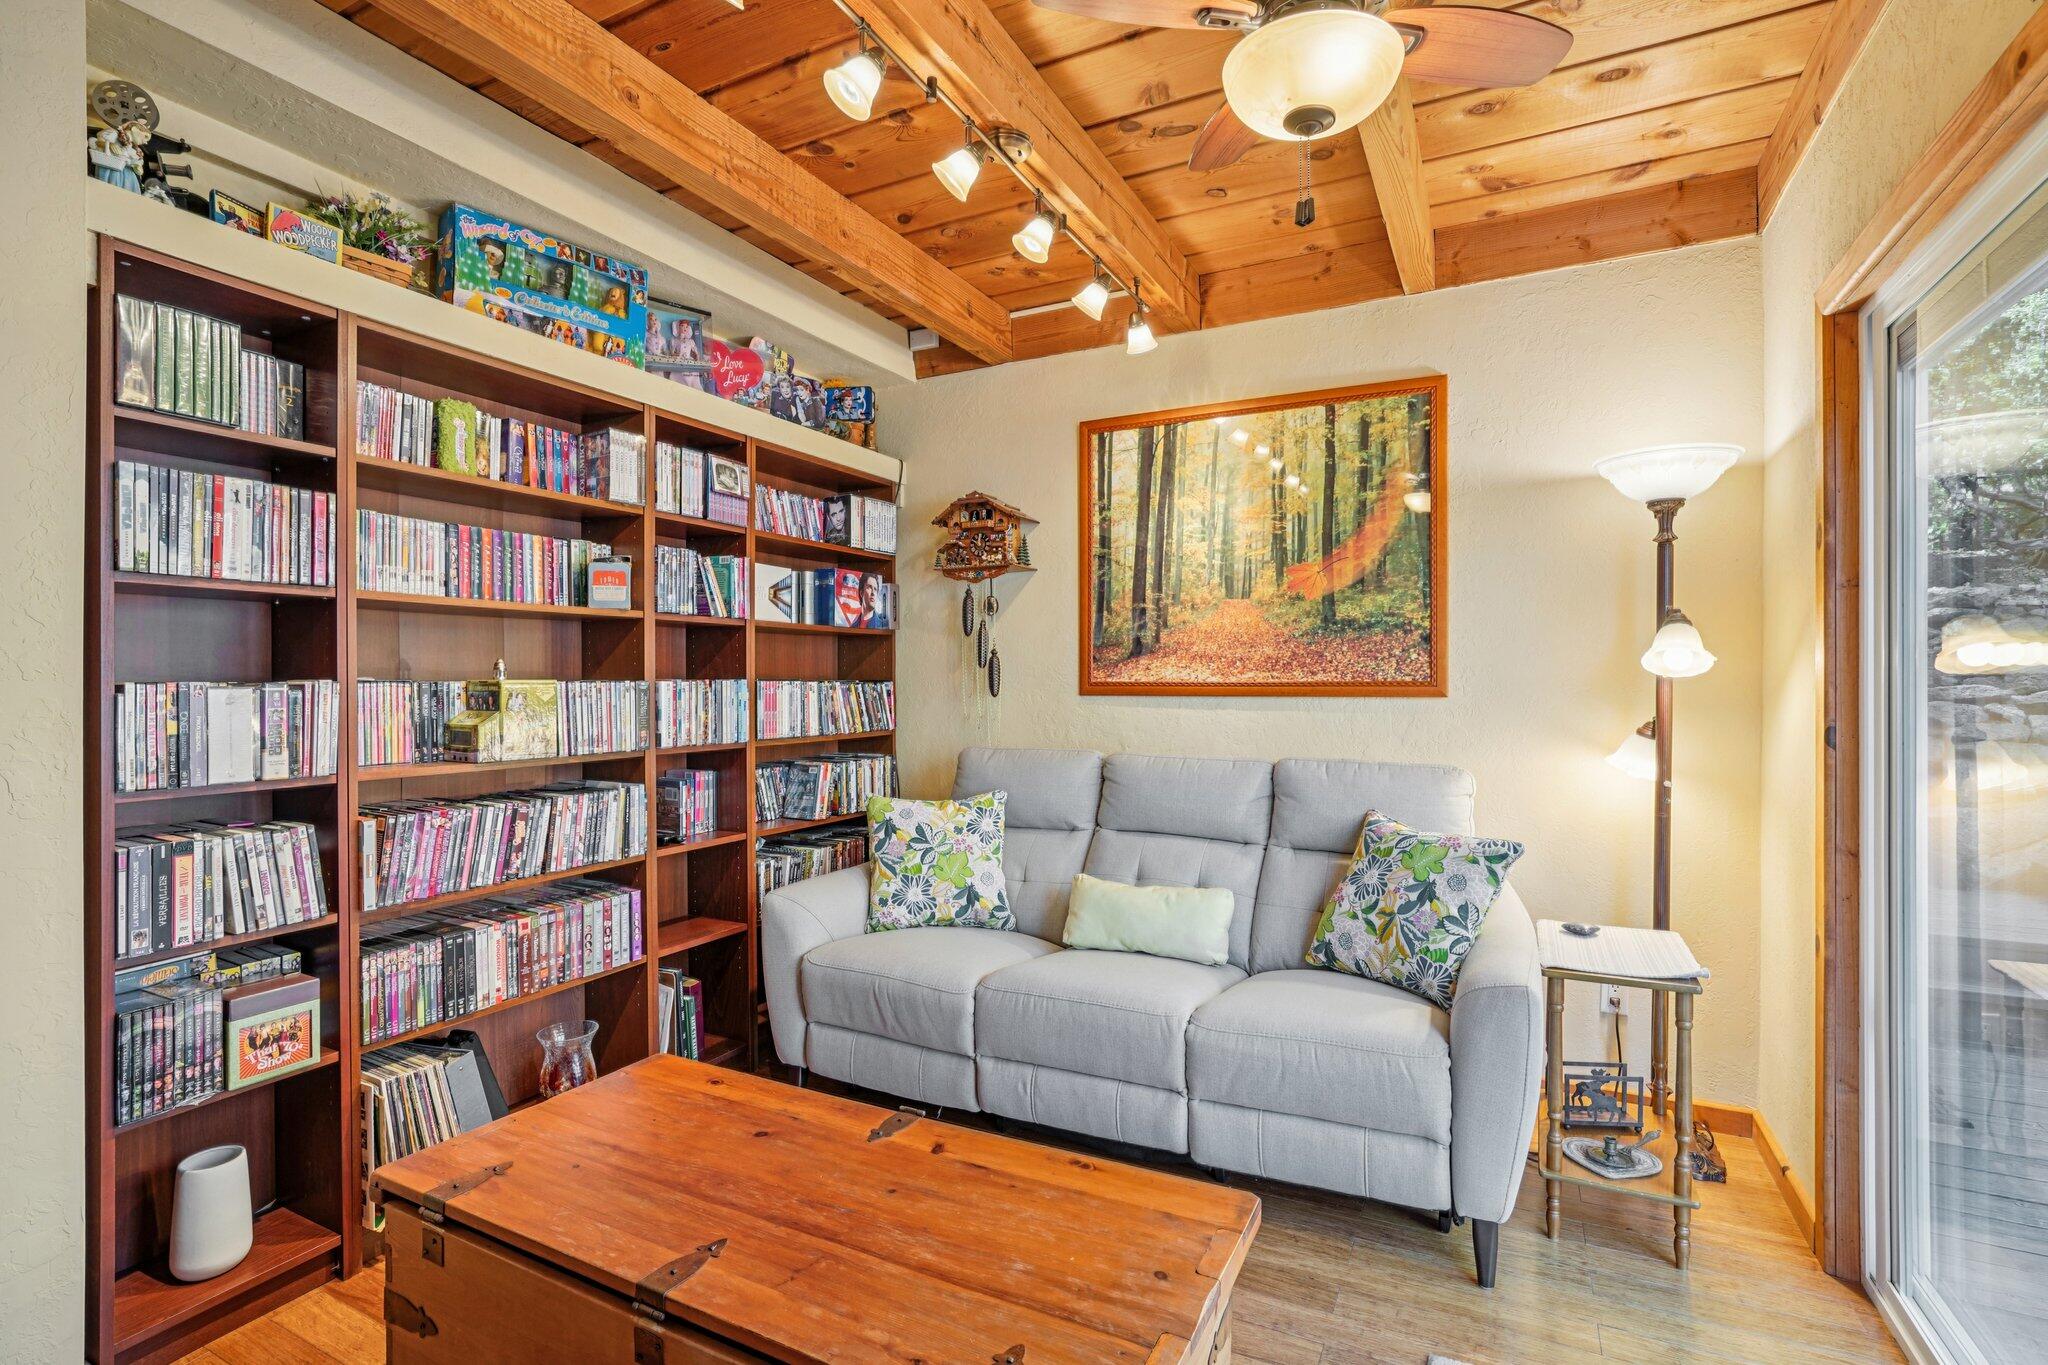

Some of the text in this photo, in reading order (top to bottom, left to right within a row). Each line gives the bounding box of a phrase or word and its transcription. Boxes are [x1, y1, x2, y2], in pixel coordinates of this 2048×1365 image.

[301, 219, 333, 237] WOODY
[272, 229, 338, 252] WOODPECKER
[720, 355, 744, 372] Love
[723, 371, 750, 387] Lucy
[180, 711, 188, 734] ONCE
[159, 875, 169, 926] VERSAILLES
[245, 1043, 278, 1064] That
[257, 1052, 292, 1069] Show
